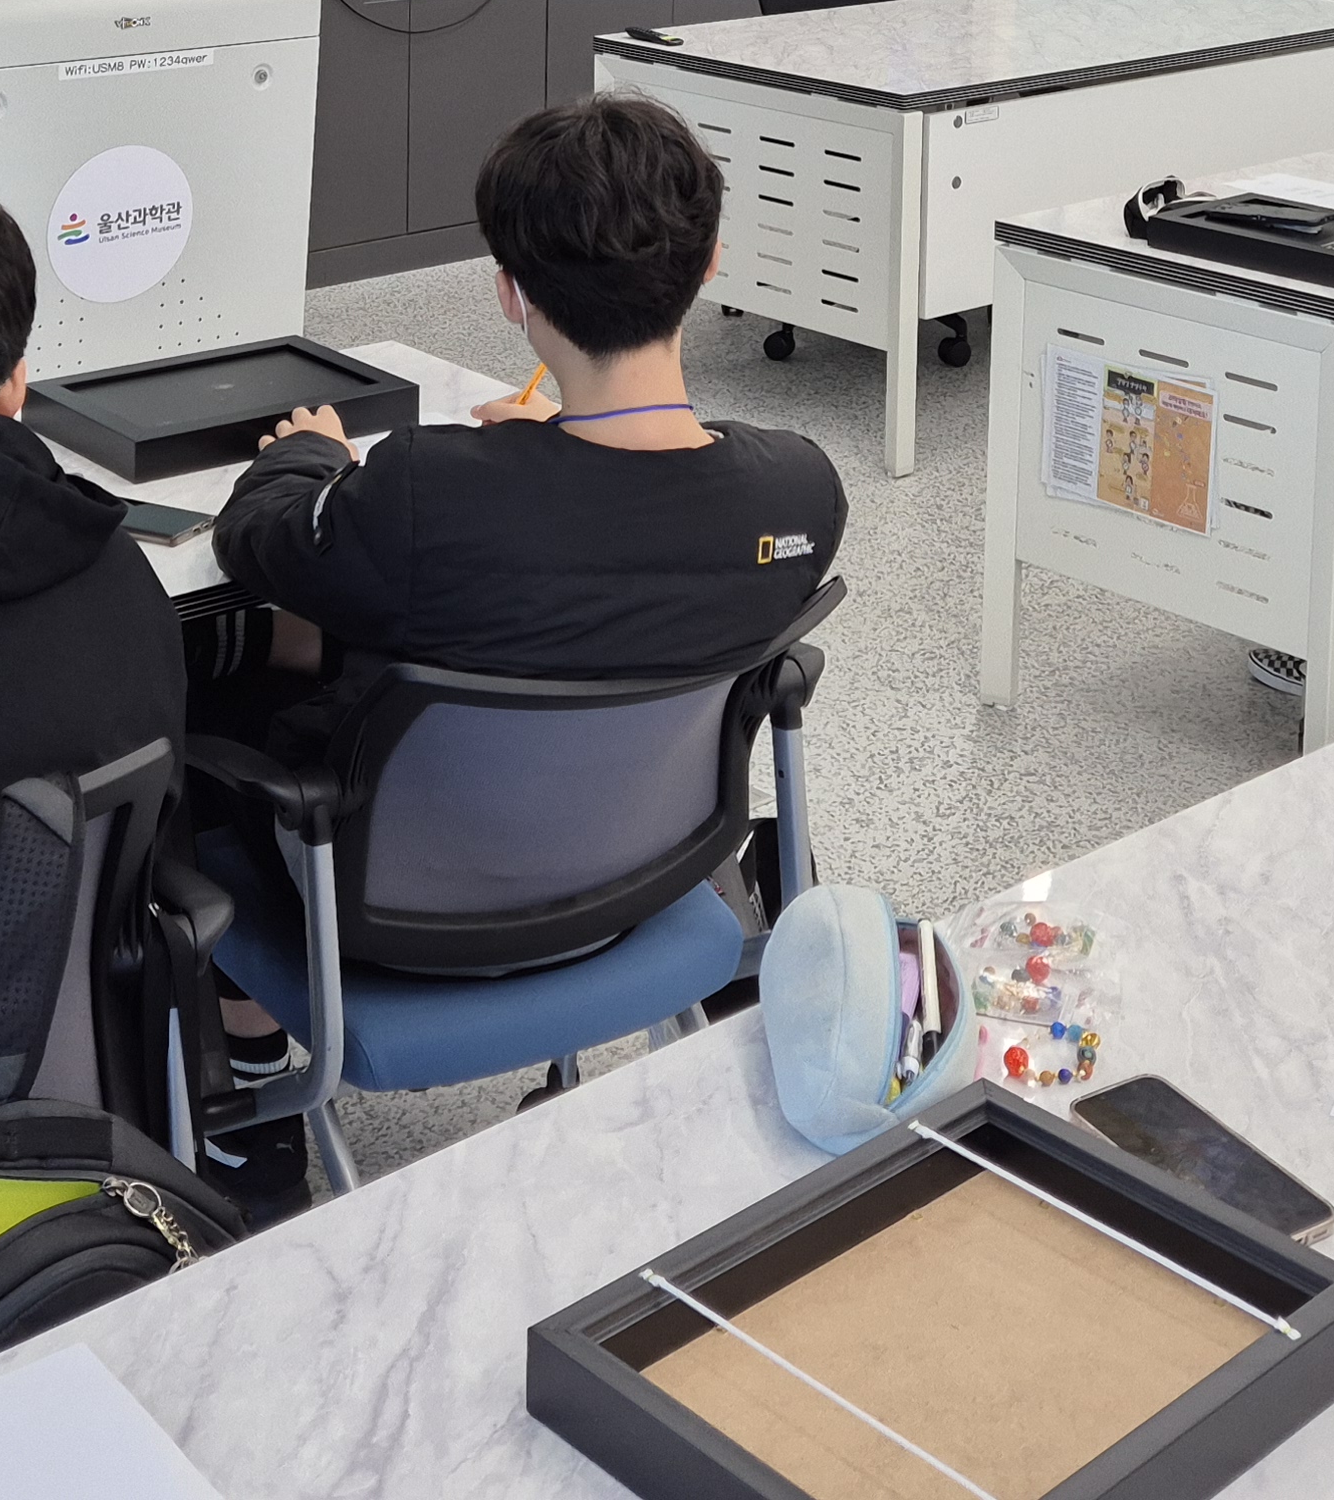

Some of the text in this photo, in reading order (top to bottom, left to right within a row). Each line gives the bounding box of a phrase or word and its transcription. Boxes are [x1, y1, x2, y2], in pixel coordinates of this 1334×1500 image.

[65, 52, 209, 77] Wifi:USM8 PW:1234qwer
[97, 201, 183, 235] 울산과학관
[98, 223, 182, 244] Ulsan Science Museum
[775, 533, 808, 550] NATIONAL
